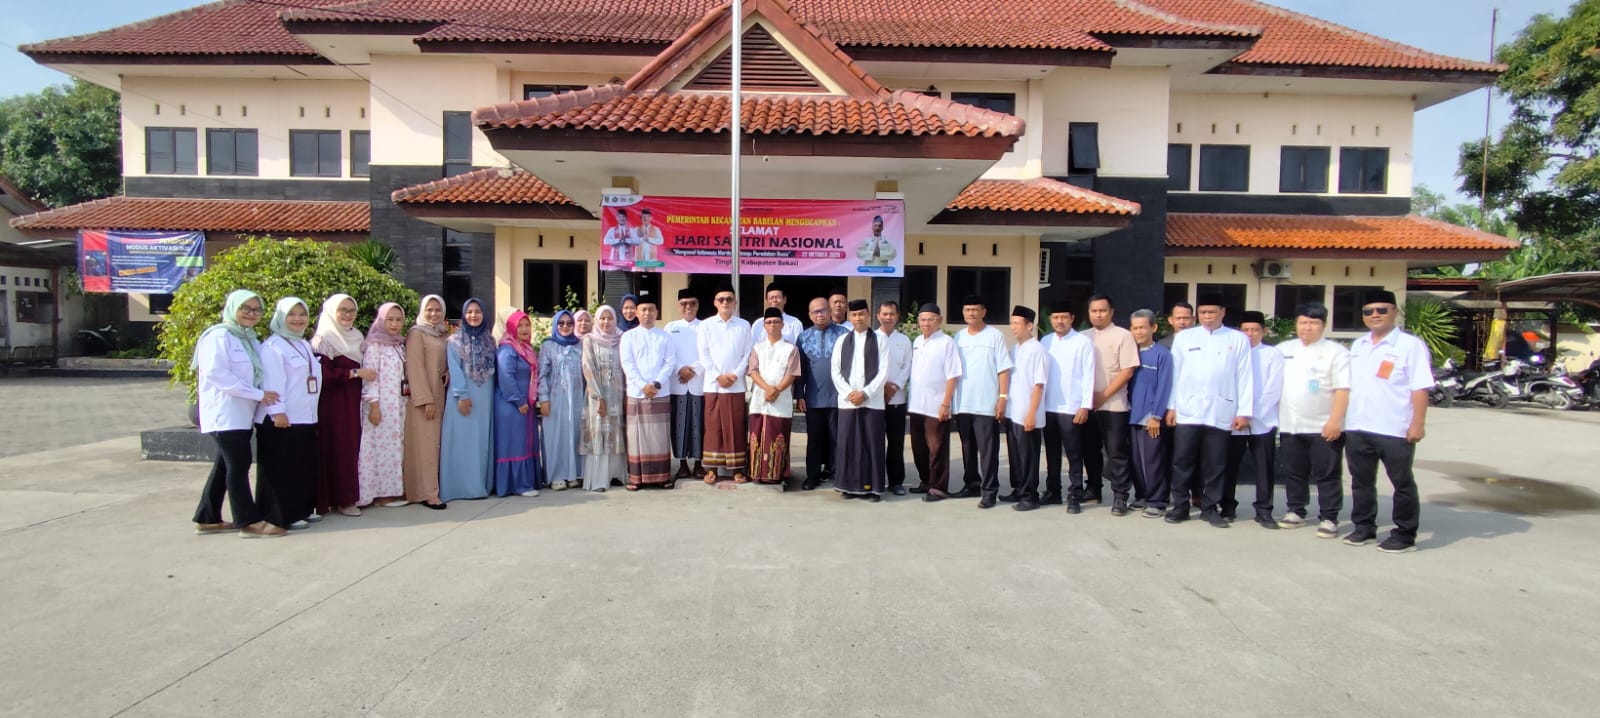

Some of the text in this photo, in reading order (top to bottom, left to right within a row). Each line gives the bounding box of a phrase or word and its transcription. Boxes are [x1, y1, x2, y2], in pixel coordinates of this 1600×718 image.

[666, 215, 710, 224] PEMERINTAH
[752, 217, 784, 226] BABELAN
[729, 225, 780, 235] LAMAT
[675, 235, 844, 249] HARI SATRI NASIONAL
[740, 259, 776, 268] Kabupaten
